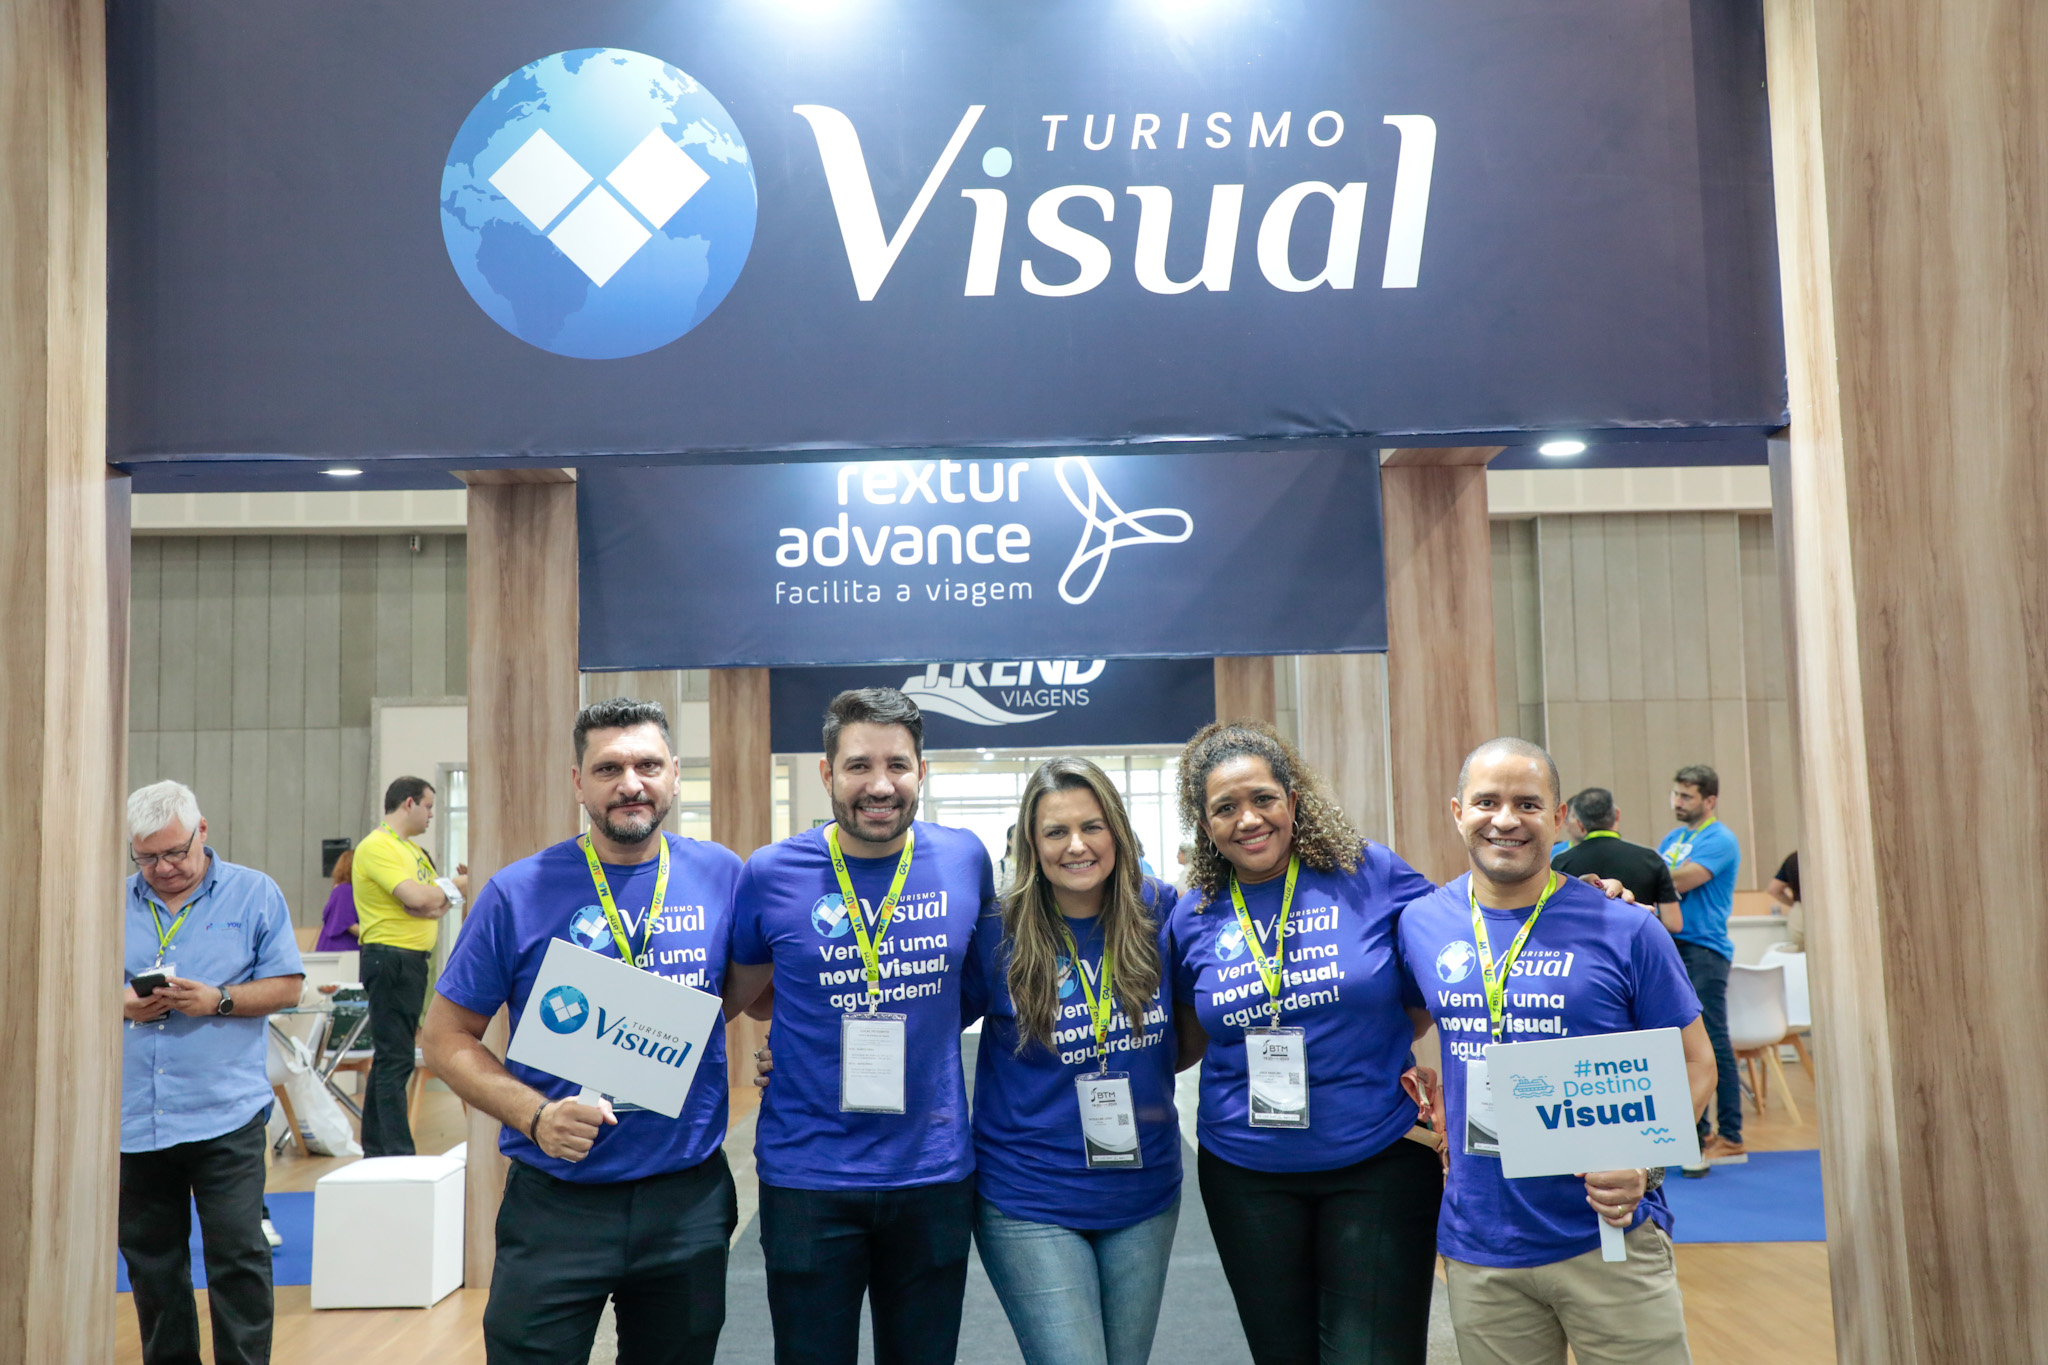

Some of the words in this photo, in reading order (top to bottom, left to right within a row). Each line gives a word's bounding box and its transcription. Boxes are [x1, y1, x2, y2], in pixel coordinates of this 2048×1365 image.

[1041, 110, 1346, 152] TURISMO
[792, 102, 1437, 302] Visual
[837, 459, 1029, 506] rextur
[775, 512, 1031, 568] advance
[896, 583, 911, 602] a
[926, 579, 1033, 607] viagem
[1000, 688, 1090, 708] VIAGENS
[660, 904, 693, 914] RISMO
[859, 891, 948, 927] Vsual
[900, 892, 936, 903] URISMO
[844, 889, 864, 933] MANAUS
[877, 891, 898, 935] MANAUS
[1290, 906, 1327, 918] URISMO
[659, 947, 707, 965] uma
[878, 936, 895, 957] aí
[900, 933, 948, 952] uma
[1289, 943, 1339, 963] uma
[1520, 950, 1560, 958] URISMO
[878, 954, 950, 980] Visual,
[1212, 981, 1264, 1007] nova
[1283, 961, 1345, 988] isual,
[1222, 985, 1340, 1028] aguardem!
[1437, 990, 1484, 1009] Vem
[1513, 993, 1565, 1010] uma
[632, 1020, 680, 1044] TURISMO
[1440, 1015, 1488, 1033] nova
[595, 1006, 693, 1069] Visual
[1269, 1044, 1289, 1053] BTM
[1573, 1056, 1649, 1079] #meu
[1097, 1091, 1116, 1099] BTM
[1563, 1075, 1652, 1098] Destino
[1535, 1094, 1657, 1131] Visual
